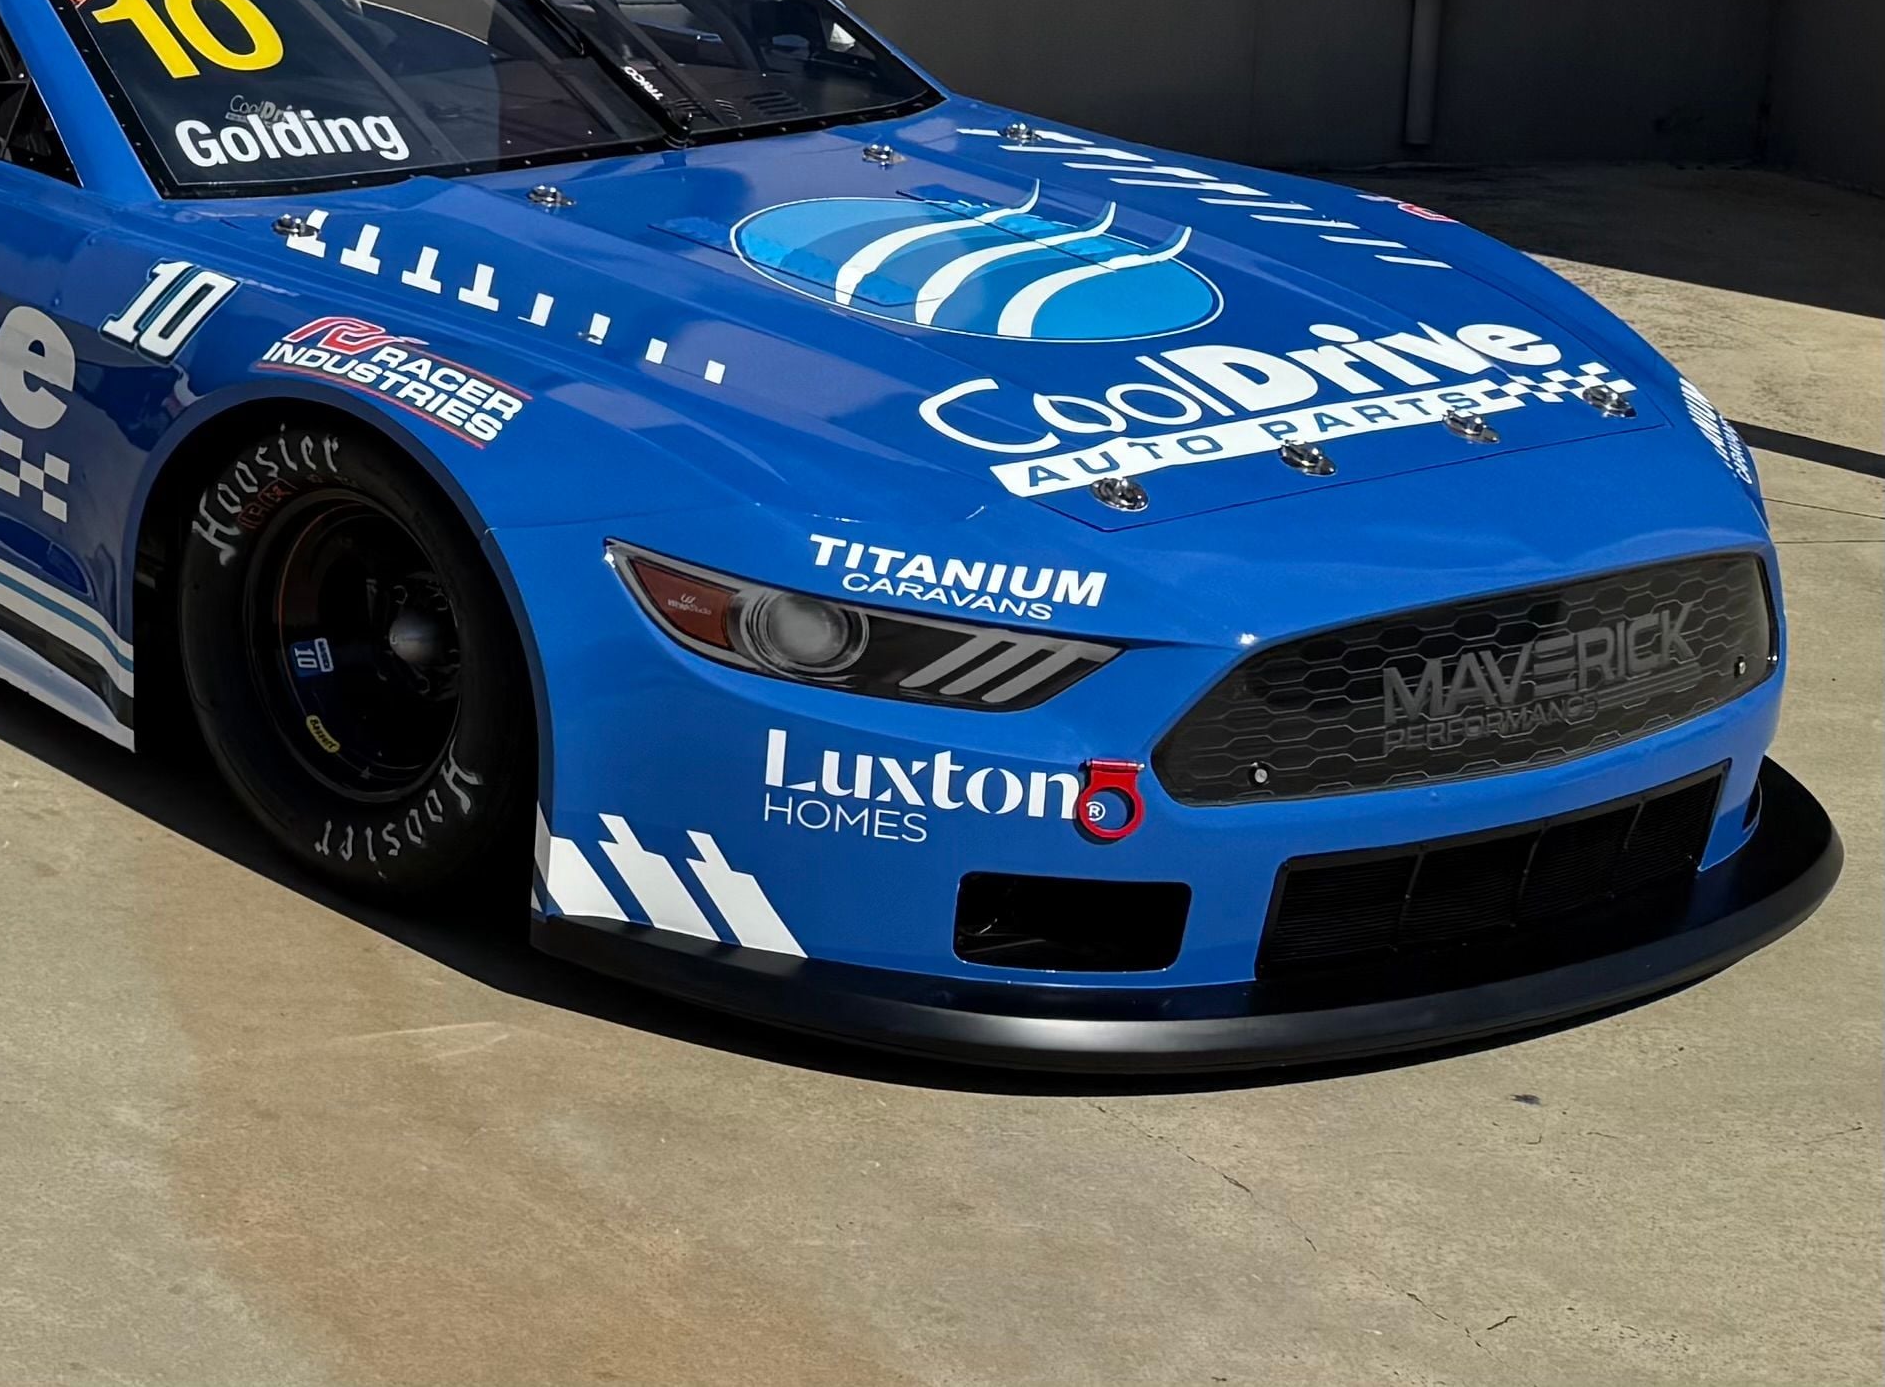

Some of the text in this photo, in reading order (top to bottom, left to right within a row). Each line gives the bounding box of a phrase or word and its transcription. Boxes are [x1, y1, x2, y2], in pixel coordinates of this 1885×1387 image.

[175, 109, 410, 168] Golding
[101, 259, 241, 366] 10
[262, 341, 505, 444] INDUSTRIES
[368, 345, 527, 423] RACER
[919, 321, 1562, 456] CoolDrive
[1025, 387, 1483, 490] AUTO PARTS
[190, 422, 342, 567] Hoosier
[809, 533, 1108, 609] TITANIUM
[841, 572, 1054, 622] CARAVANS
[293, 646, 319, 669] 10
[1381, 601, 1696, 725] MAVERICK
[314, 735, 483, 880] Hoosier
[762, 792, 929, 844] HOMES
[764, 727, 1082, 821] Luxton
